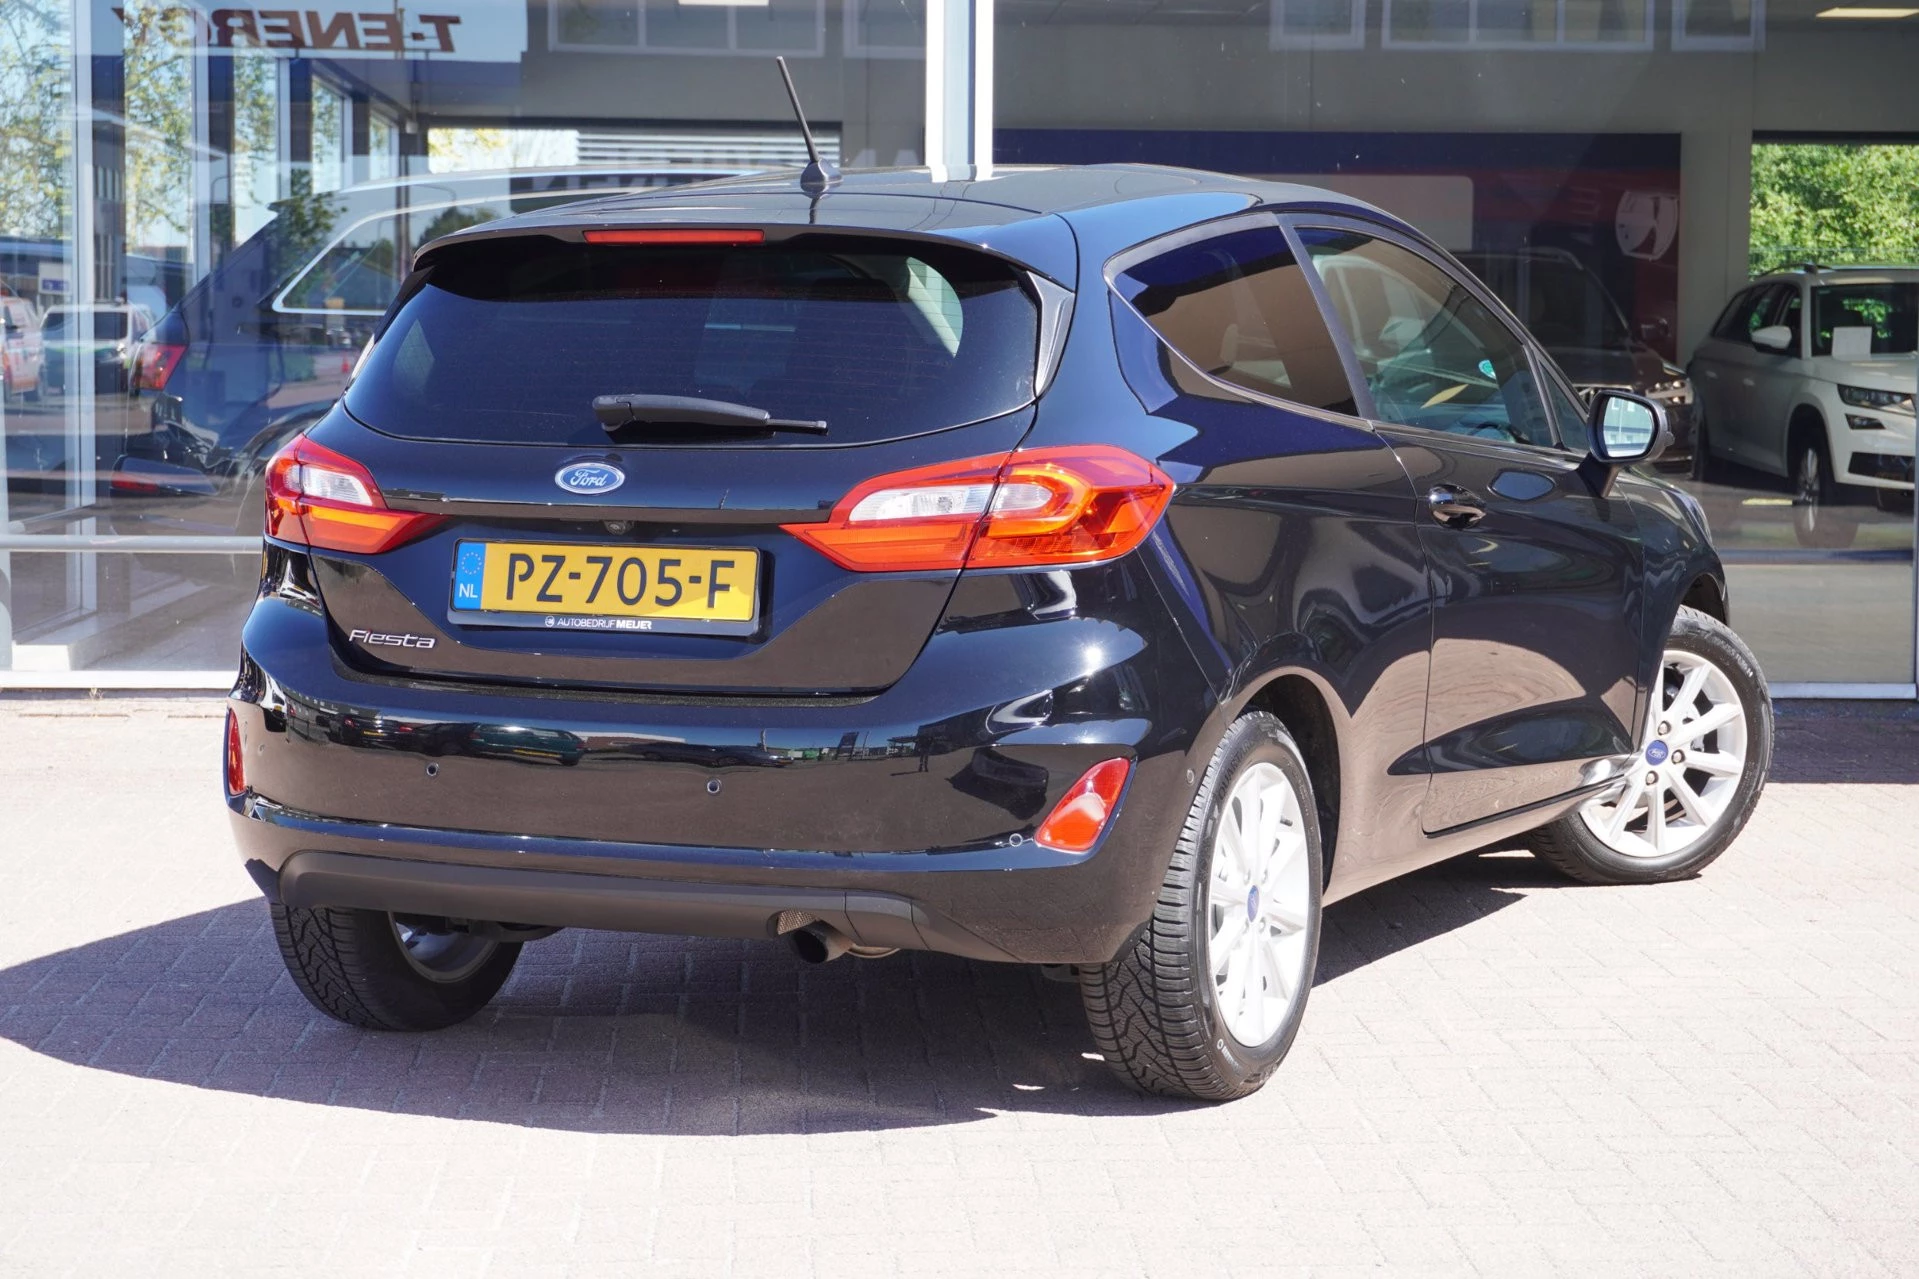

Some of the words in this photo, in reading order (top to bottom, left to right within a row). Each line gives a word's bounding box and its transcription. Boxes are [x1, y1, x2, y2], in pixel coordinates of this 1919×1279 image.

[569, 468, 609, 487] Ford
[505, 552, 736, 609] PZ-705-F
[458, 583, 478, 599] NL
[556, 617, 616, 630] AUTOBEDRIJF
[348, 628, 436, 649] Fiesta
